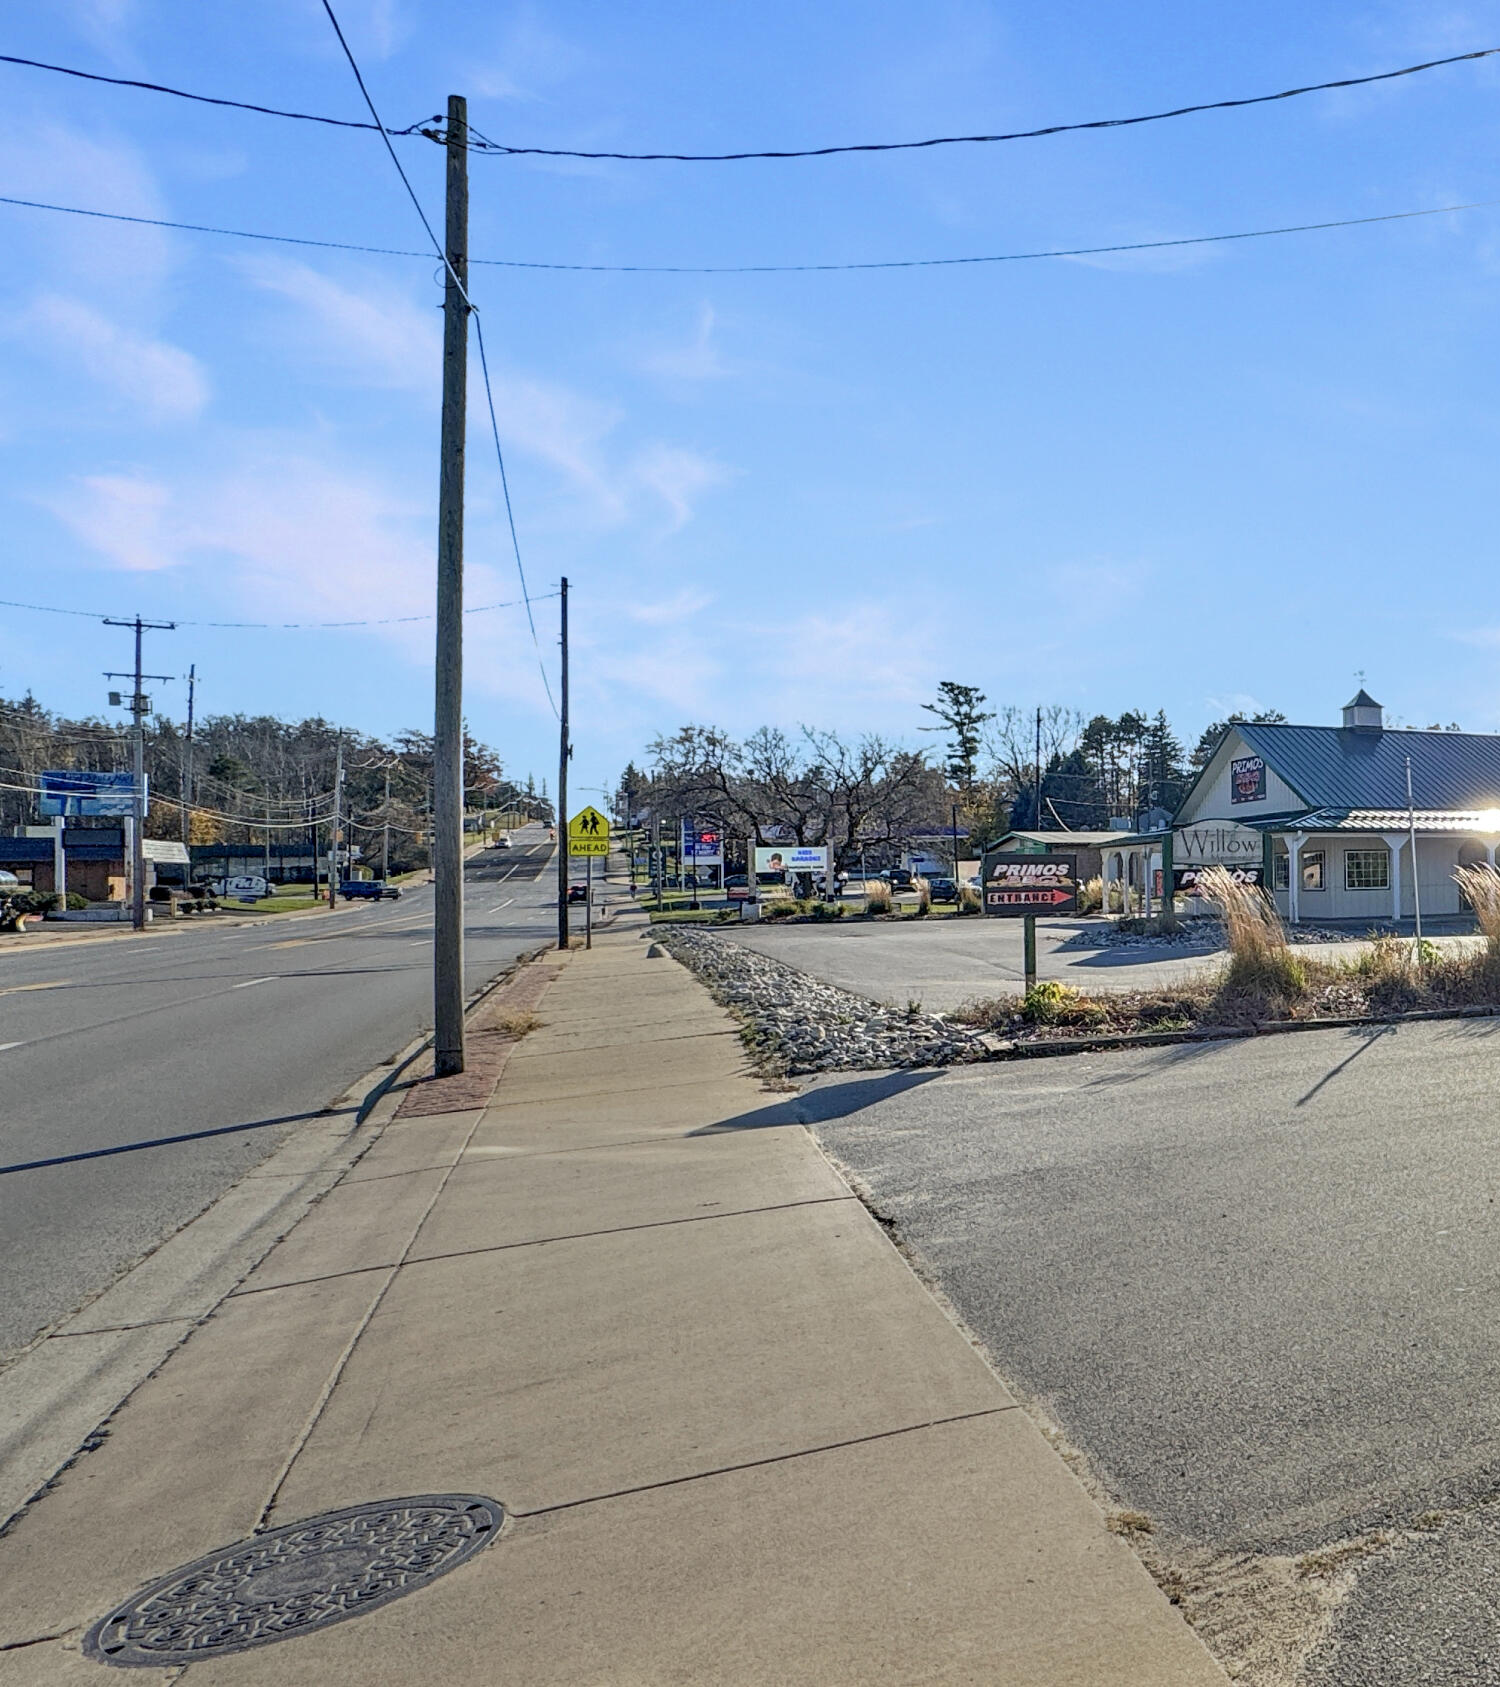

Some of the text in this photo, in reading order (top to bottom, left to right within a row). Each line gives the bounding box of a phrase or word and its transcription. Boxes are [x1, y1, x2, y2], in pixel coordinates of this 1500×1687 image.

[1232, 758, 1264, 775] PRIMOS
[572, 844, 607, 852] AHEAD
[1181, 828, 1257, 857] Willow
[993, 864, 1070, 877] PRIMOS
[1180, 871, 1259, 885] PROS
[989, 893, 1056, 903] ENTRANCE
